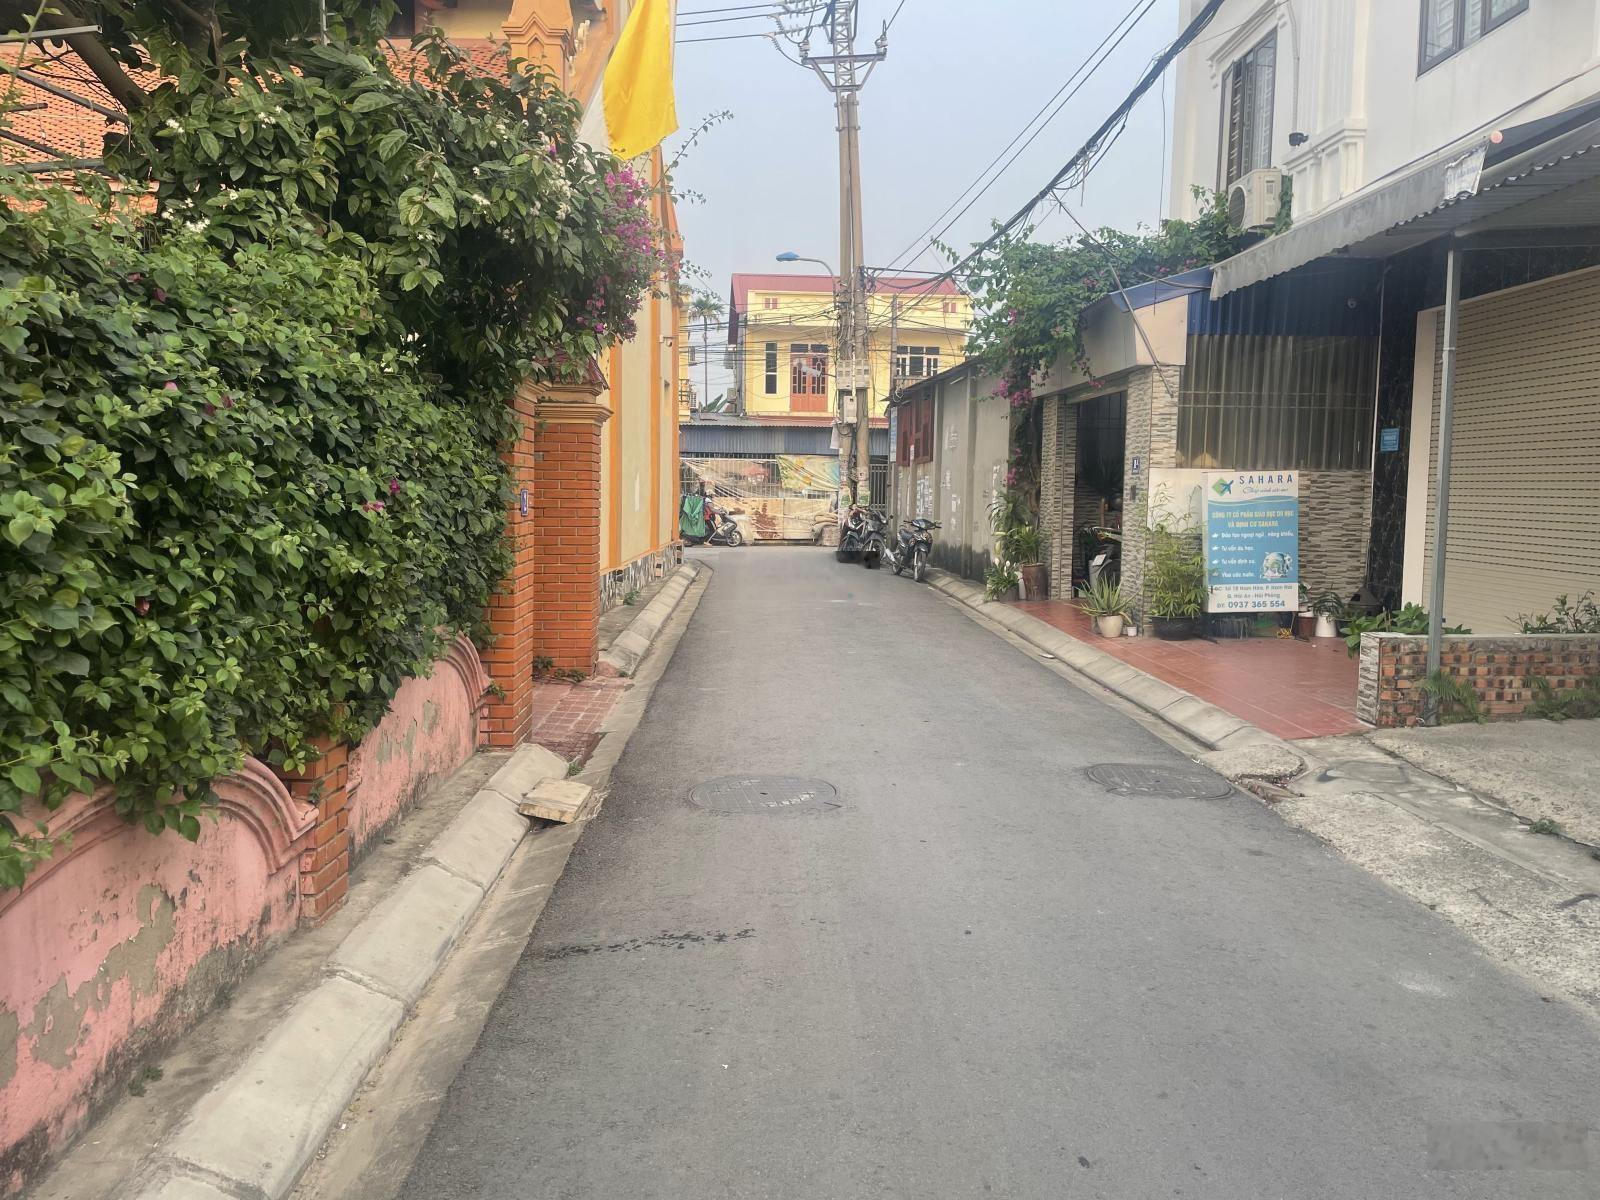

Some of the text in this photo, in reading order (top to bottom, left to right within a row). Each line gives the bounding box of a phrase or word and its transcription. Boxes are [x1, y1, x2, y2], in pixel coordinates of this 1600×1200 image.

[1239, 474, 1293, 485] SAHARA
[1228, 601, 1248, 609] 0937
[1269, 600, 1286, 608] 554
